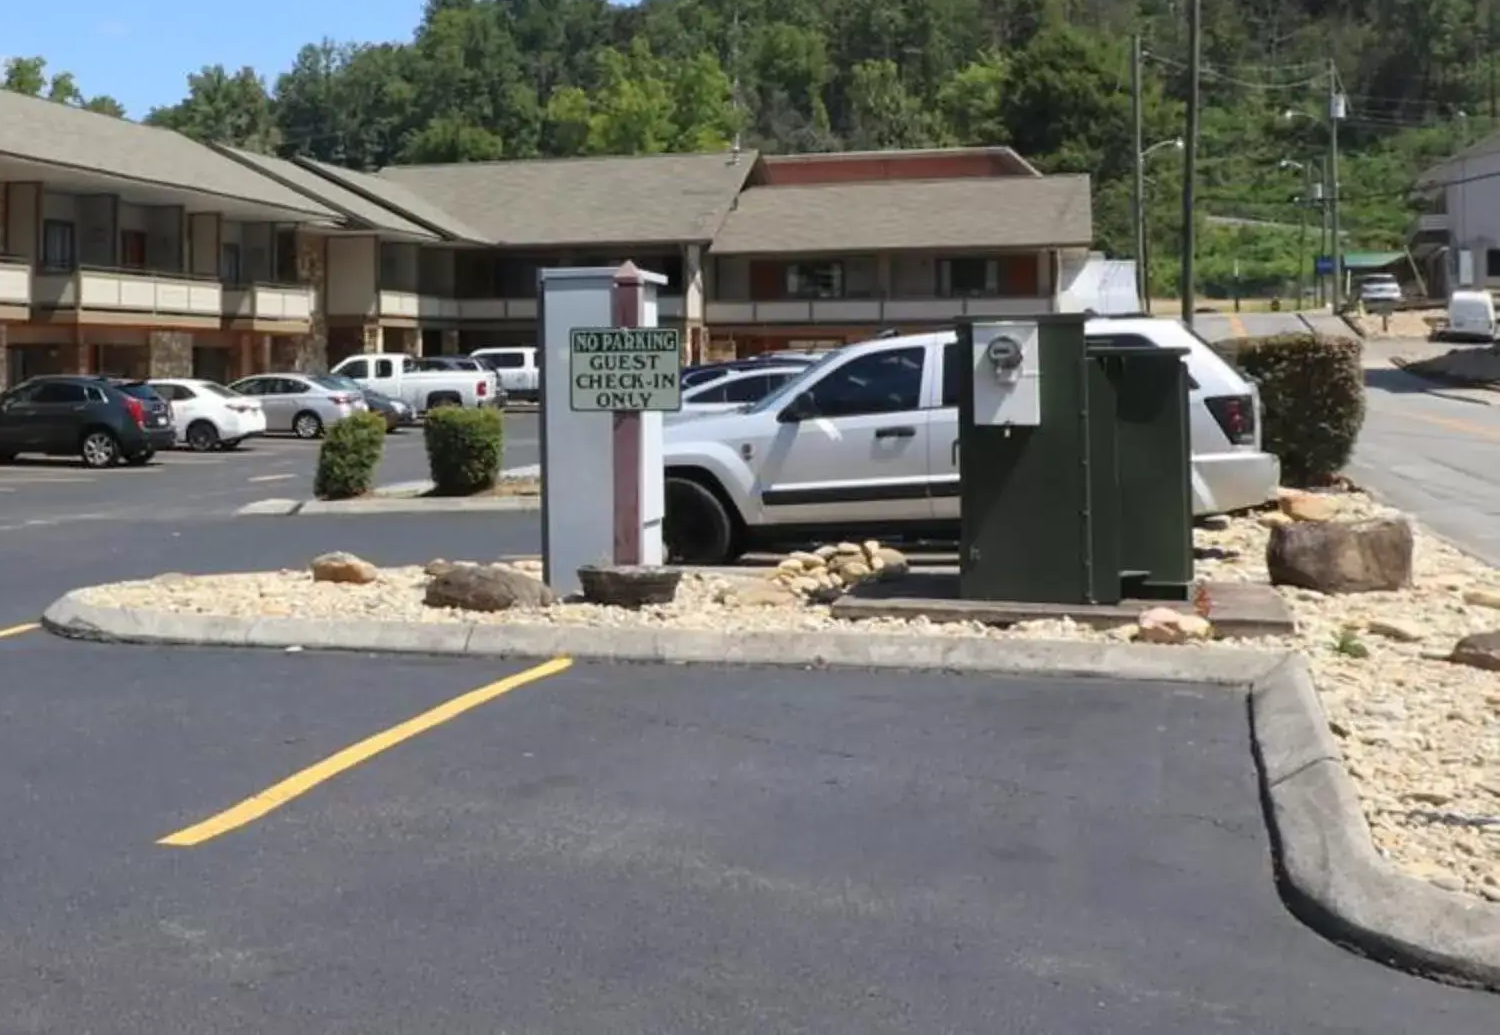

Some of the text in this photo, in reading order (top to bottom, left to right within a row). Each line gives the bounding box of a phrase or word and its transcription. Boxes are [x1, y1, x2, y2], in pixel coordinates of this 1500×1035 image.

[575, 332, 675, 351] NO PARKING
[589, 355, 660, 370] GUEST
[576, 373, 675, 389] CHECK-IN
[596, 392, 652, 407] ONLY
